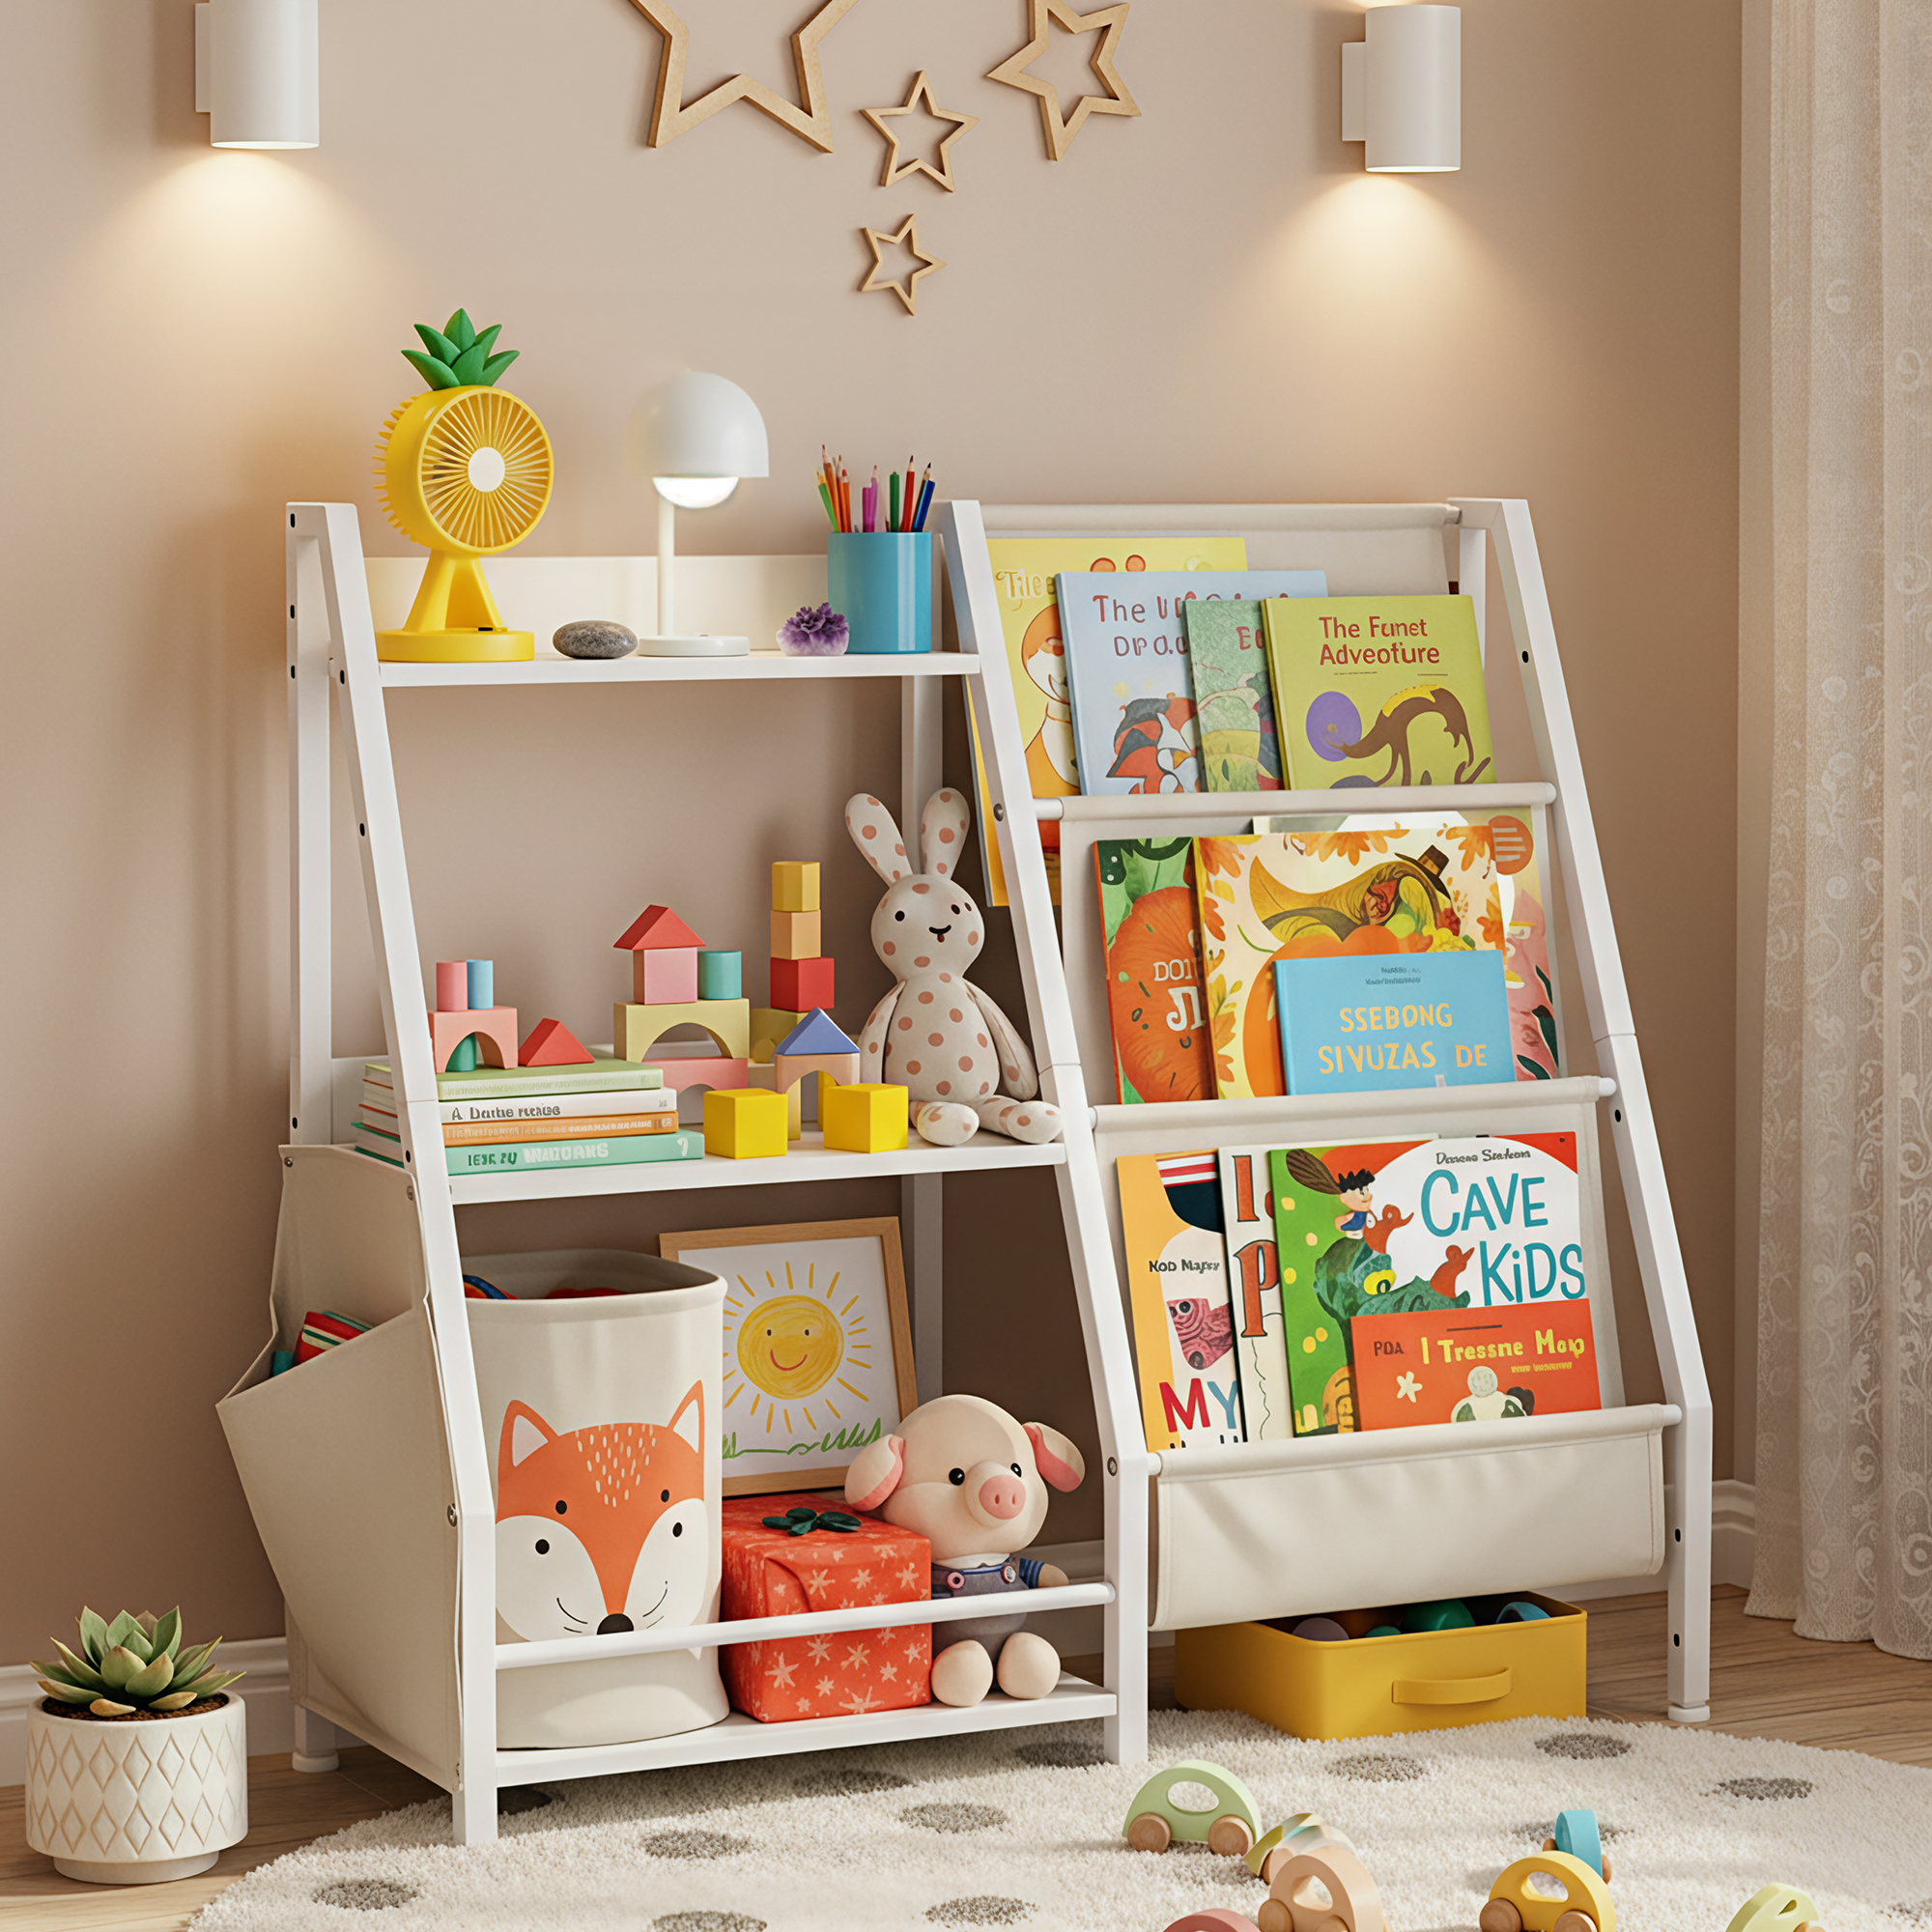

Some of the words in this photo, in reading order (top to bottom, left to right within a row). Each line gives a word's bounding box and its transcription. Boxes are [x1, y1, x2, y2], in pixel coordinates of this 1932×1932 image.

[1093, 594, 1146, 623] The
[1319, 616, 1360, 639] The
[1340, 1003, 1453, 1033] SSEBONG
[1455, 1044, 1488, 1067] DE
[1421, 1169, 1548, 1237] CAVE
[1159, 1378, 1238, 1434] MY
